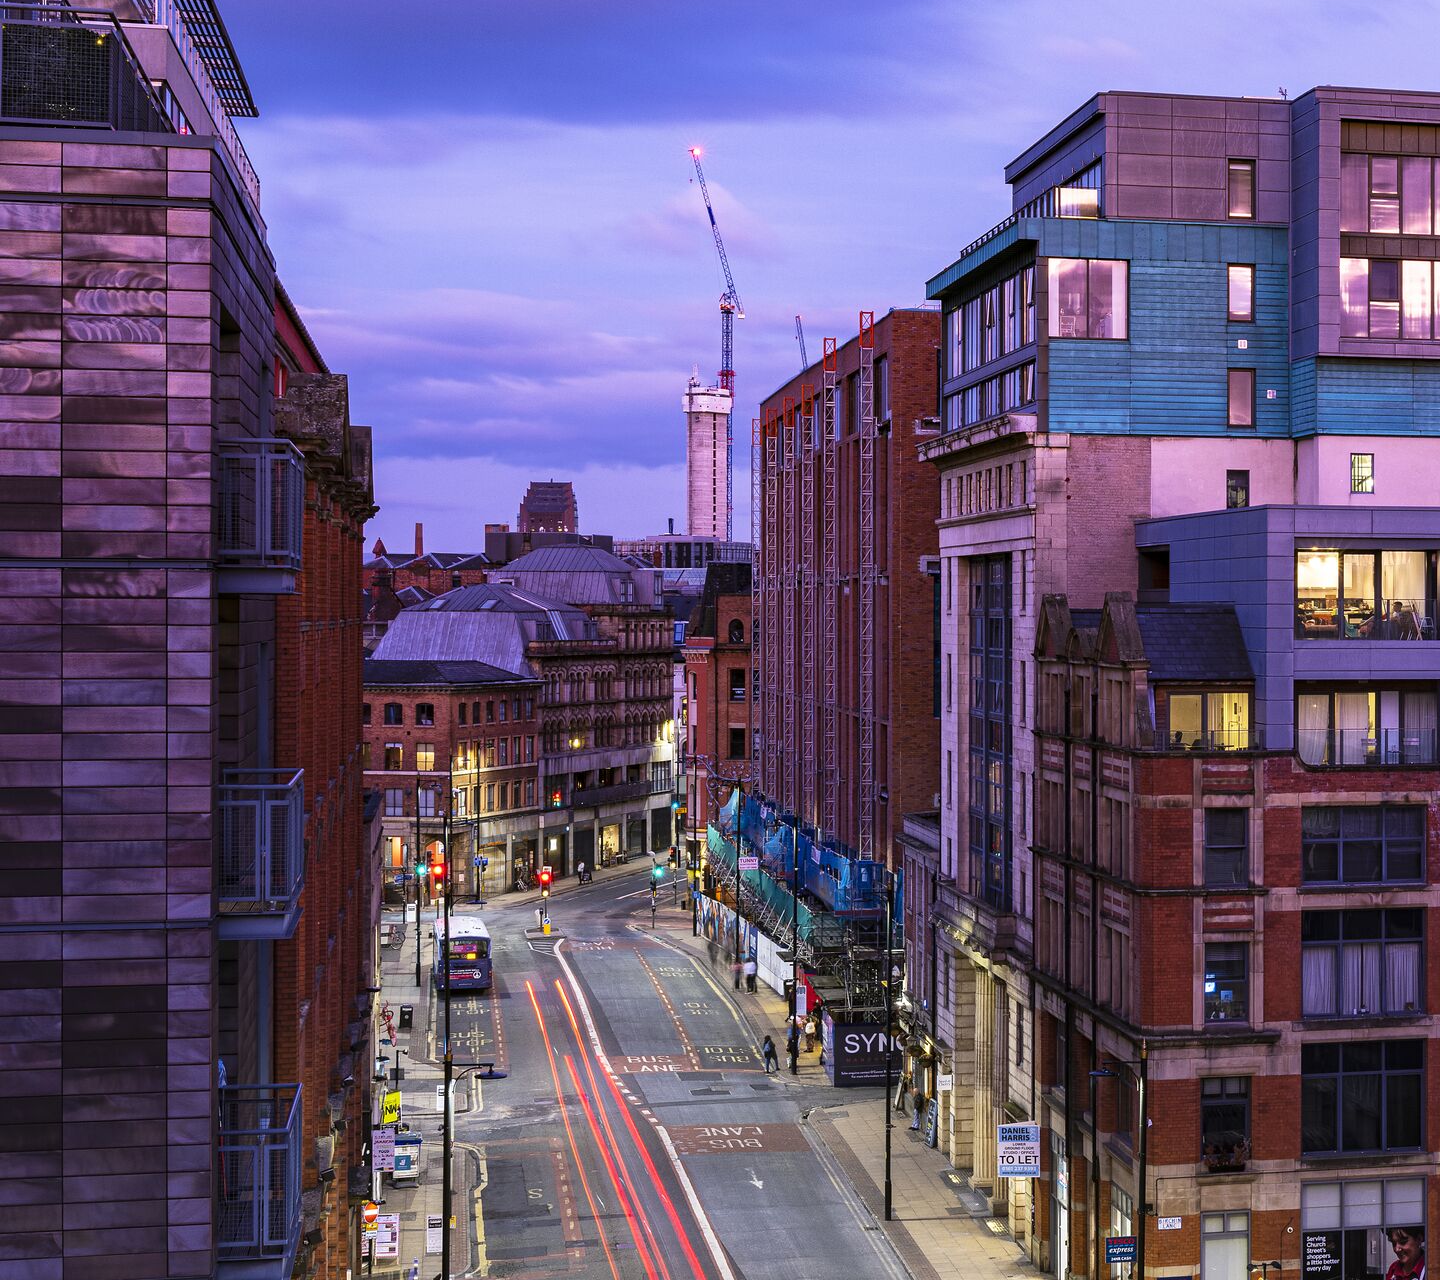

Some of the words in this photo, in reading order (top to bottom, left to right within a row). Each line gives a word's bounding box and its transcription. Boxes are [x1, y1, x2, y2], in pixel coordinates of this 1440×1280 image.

[627, 1055, 672, 1063] BUS
[624, 1064, 683, 1072] LANE
[694, 1127, 763, 1138] LANE
[710, 1139, 763, 1149] BUS
[999, 1155, 1015, 1165] TO
[1018, 1155, 1039, 1165] LET
[1109, 1246, 1133, 1254] express
